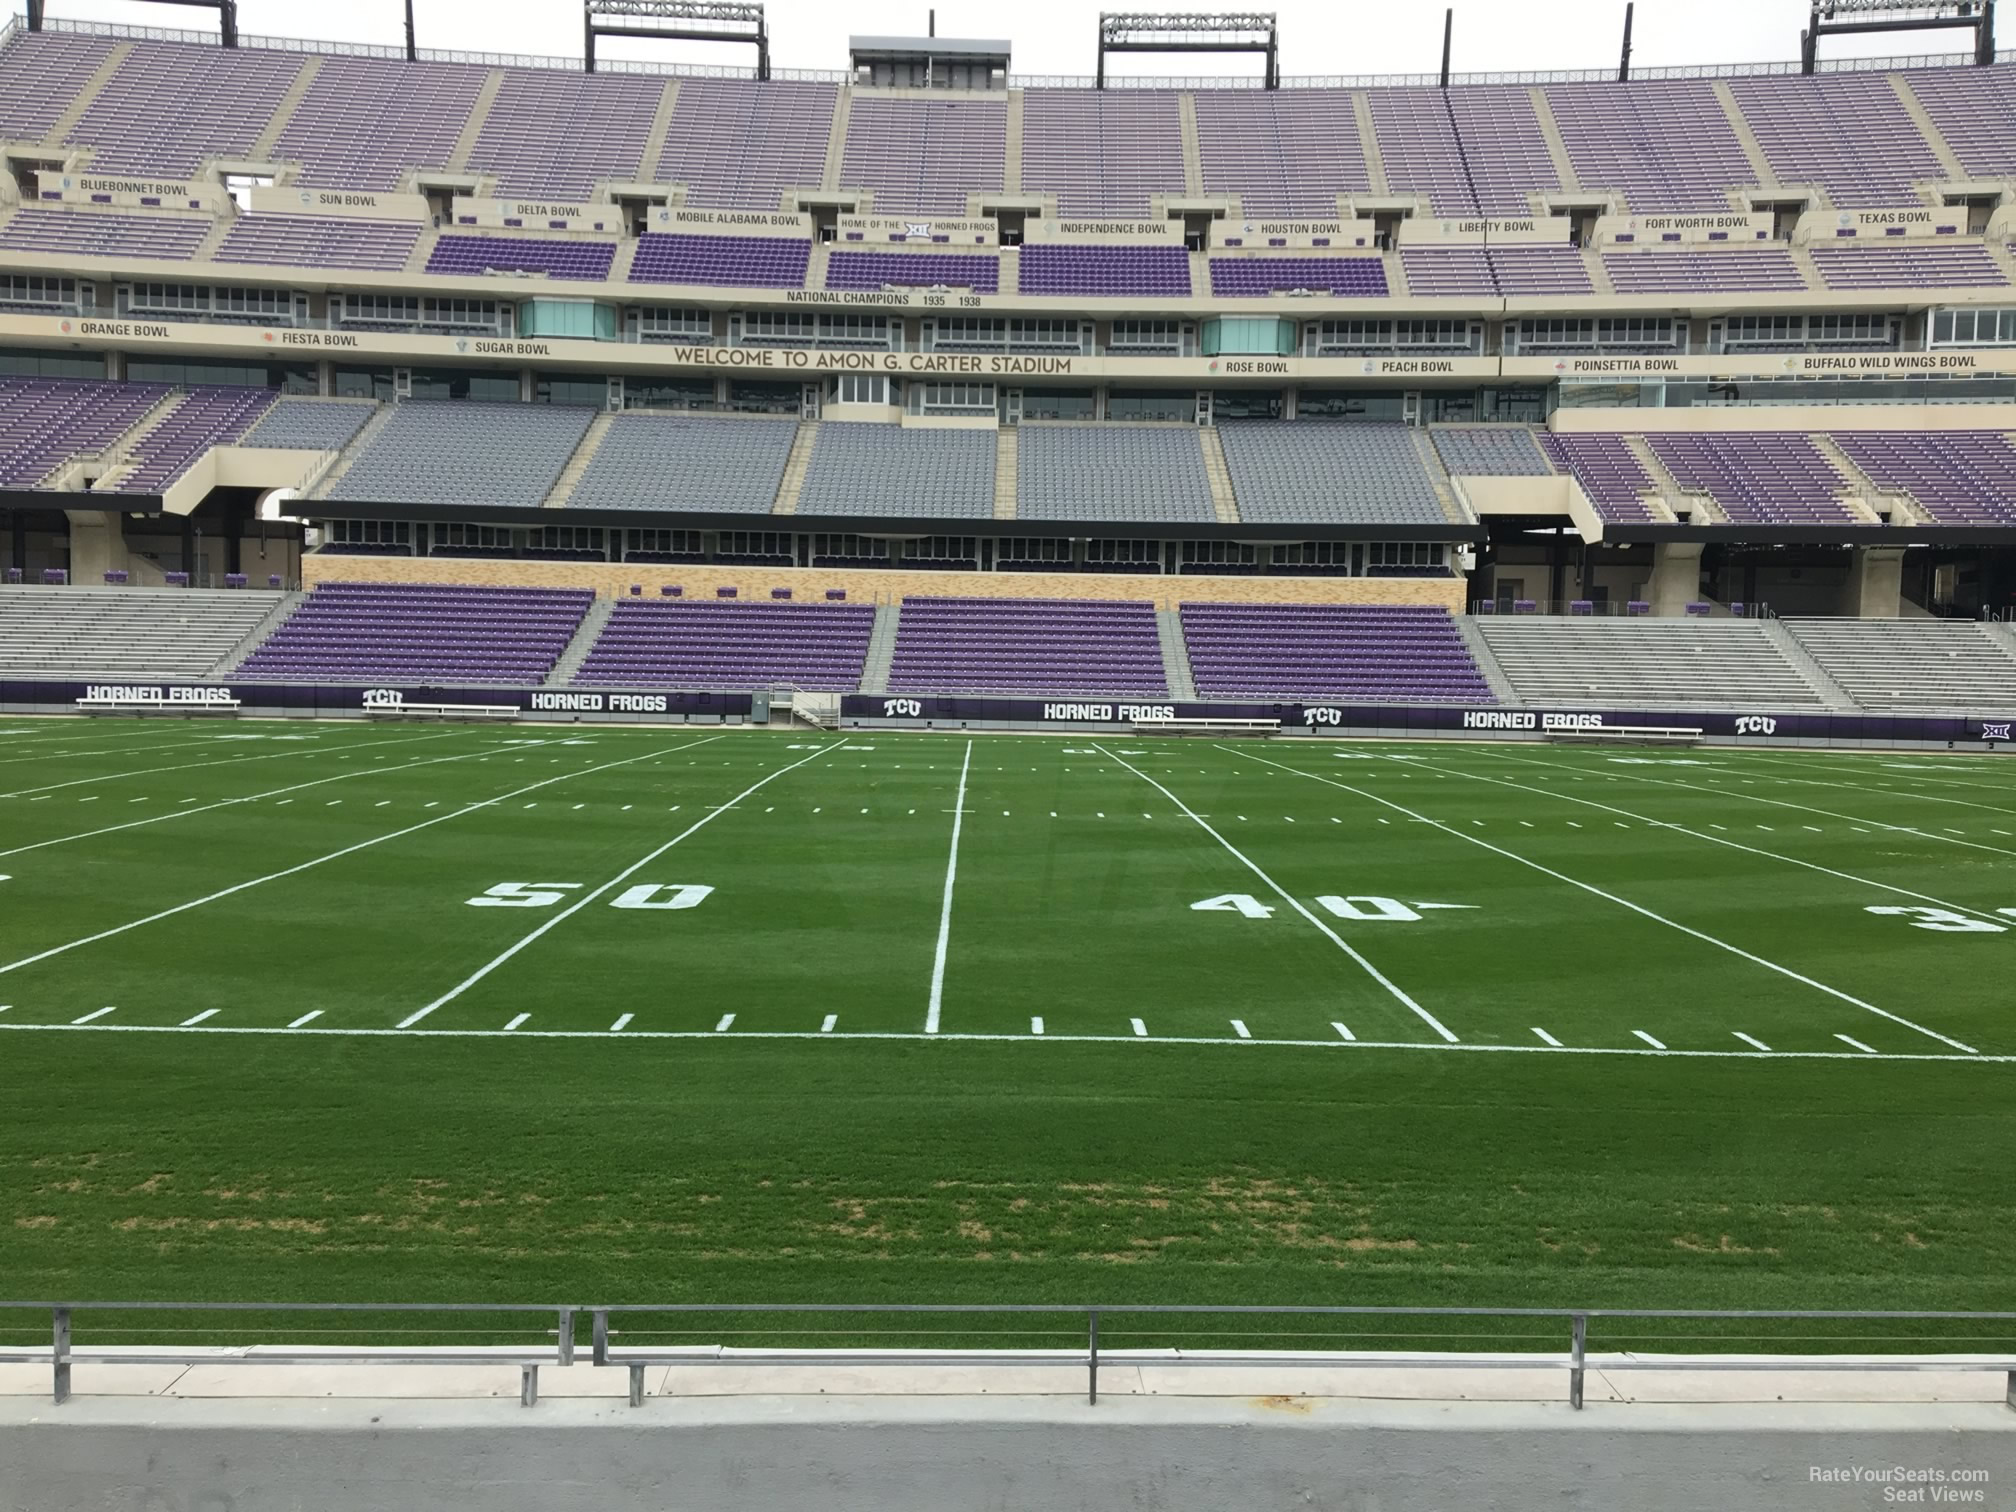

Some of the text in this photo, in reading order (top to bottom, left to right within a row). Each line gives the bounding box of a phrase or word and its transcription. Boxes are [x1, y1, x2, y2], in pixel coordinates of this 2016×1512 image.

[80, 179, 188, 196] BLUEBONNET BOWL
[319, 193, 376, 207] SUN BOWL
[517, 204, 581, 217] DELTA BOWL
[676, 212, 801, 226] MOBILE ALABAMA BOWL
[841, 219, 867, 228] HOME
[870, 220, 881, 229] OF
[884, 220, 899, 229] THE
[935, 222, 967, 231] HORNED
[969, 223, 995, 231] FROGS
[1645, 217, 1750, 229] FORT WORTH BOWL
[1858, 212, 1932, 224] TEXAS BOWL
[1060, 223, 1167, 234] INDEPENDENCE BOWL
[1261, 224, 1342, 234] HOUSTON BOWL
[1459, 221, 1535, 232] LIBERTY BOWL
[787, 291, 981, 306] NATIONAL CHAMPIONS 1935 1938
[80, 322, 170, 337] ORANGE BOWL
[282, 333, 358, 346] FIESTA BOWL
[475, 342, 550, 355] SUGAR BOWL
[674, 347, 1071, 374] WELCOME TO AMON G. CARTER STADIUM
[1226, 362, 1288, 372] ROSE BOWL
[1382, 361, 1453, 372] PEACH BOWL
[1574, 359, 1679, 371] POINSETTIA BOWL
[1804, 356, 1977, 369] BUFFALO WILD WINGS BOWL
[86, 686, 162, 700] HORNED
[362, 689, 403, 704] TCU
[531, 693, 667, 711] HORNED FROGS
[884, 699, 921, 717] TCU
[1044, 703, 1175, 721] HORNED FROGS
[1303, 707, 1342, 726] TCU
[1463, 711, 1603, 729] HORNED FROGS
[1735, 716, 1777, 735] TCU
